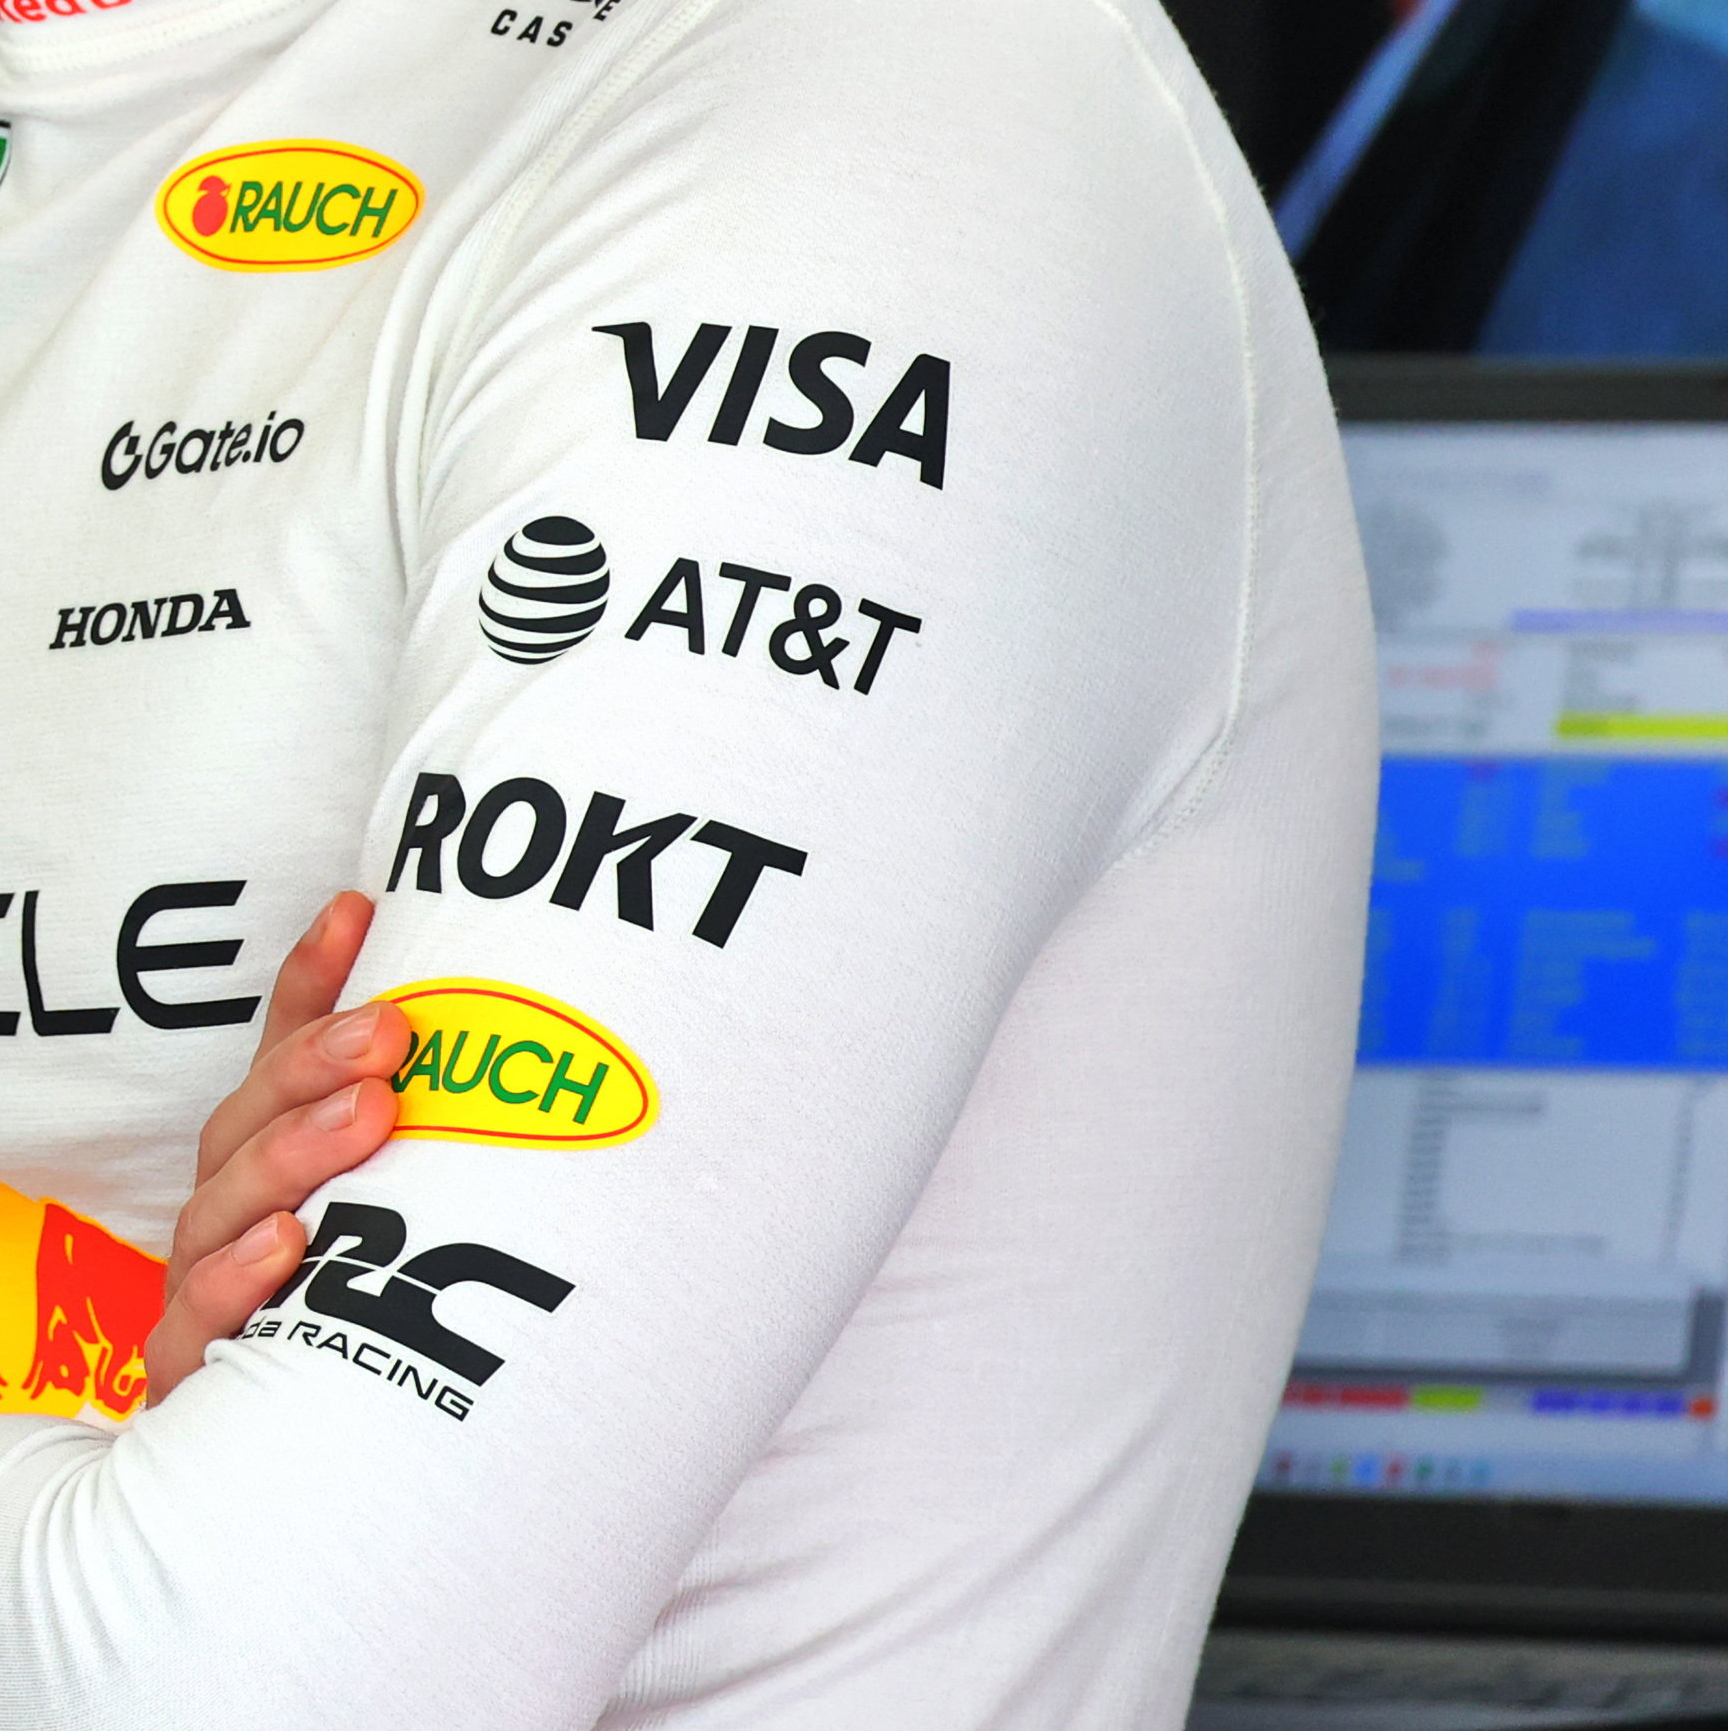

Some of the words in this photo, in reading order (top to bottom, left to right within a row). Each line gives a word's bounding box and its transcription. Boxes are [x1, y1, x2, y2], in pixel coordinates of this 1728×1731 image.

[231, 179, 398, 239] RAUCH
[144, 411, 304, 480] Gate.io
[591, 321, 951, 491] VISA
[49, 588, 251, 649] HONDA
[624, 557, 922, 696] AT&T
[386, 771, 808, 949] ROKT
[260, 1202, 576, 1387] RC
[287, 1320, 474, 1422] RACING
